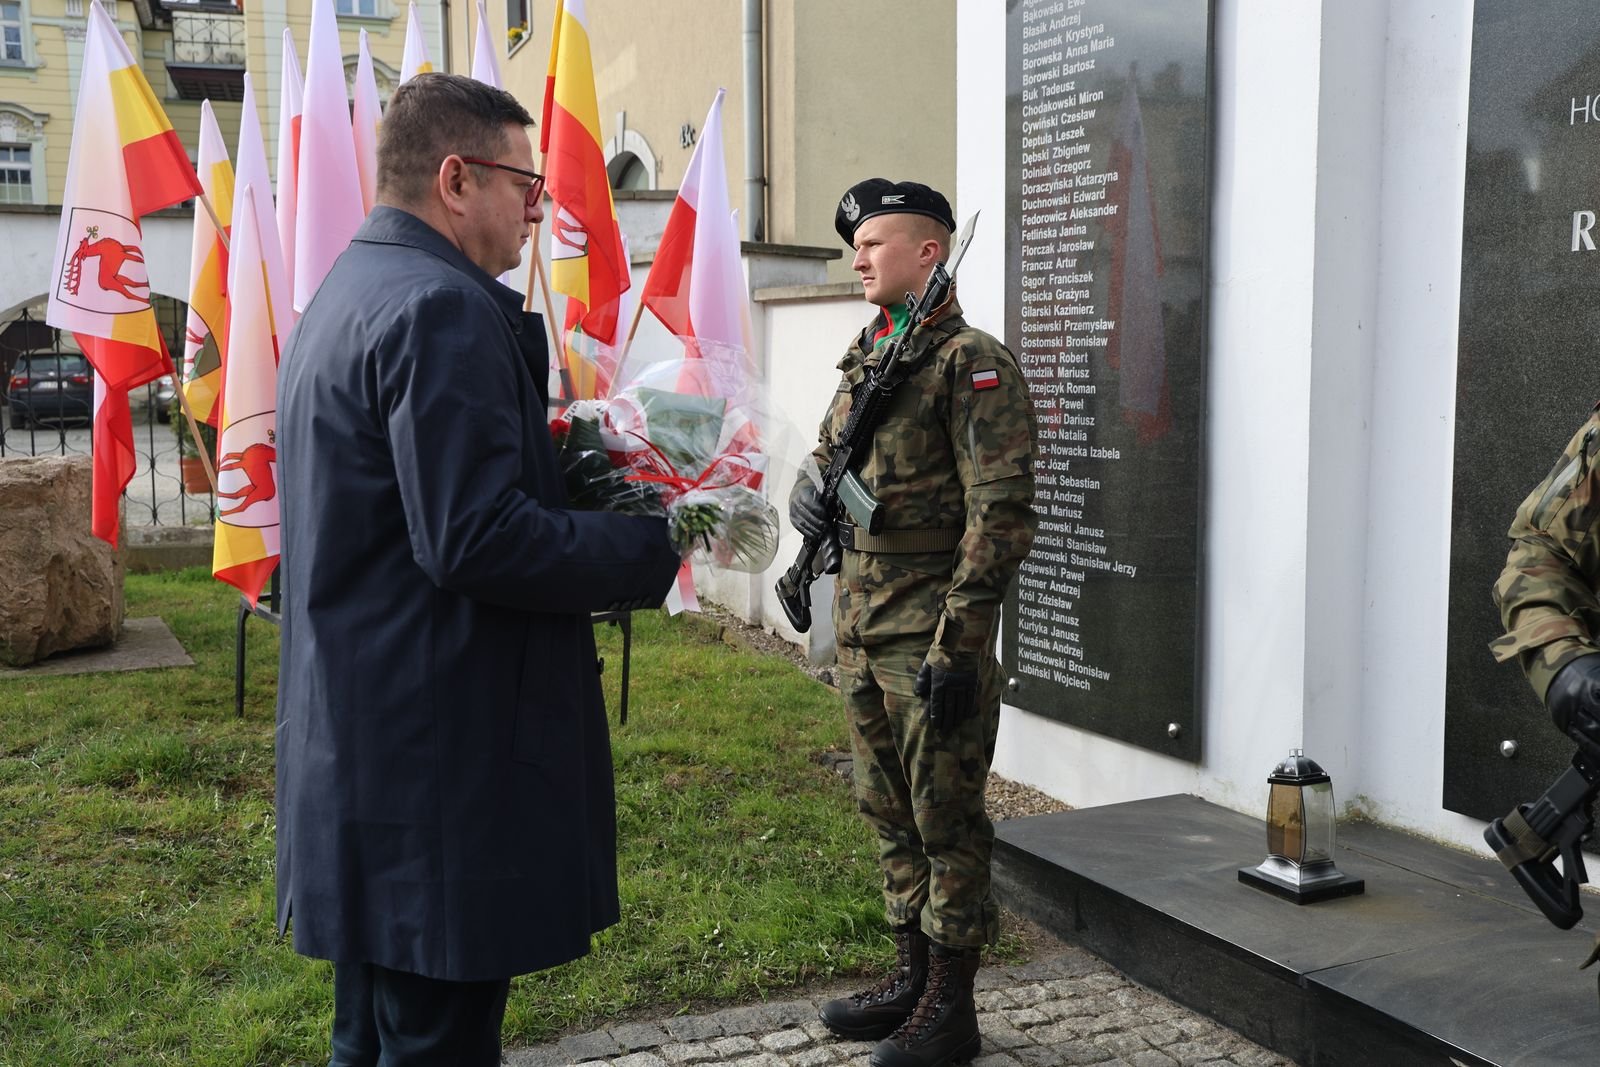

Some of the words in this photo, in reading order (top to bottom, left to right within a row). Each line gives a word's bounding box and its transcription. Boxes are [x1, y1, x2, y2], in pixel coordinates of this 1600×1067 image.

[1023, 1, 1063, 23] Bąkowska
[1023, 22, 1047, 38] Błasik
[1049, 12, 1080, 31] Andrzej
[1023, 36, 1062, 54] Bochenek
[1066, 23, 1104, 42] Krystyna
[1023, 51, 1062, 70] Borowska
[1066, 44, 1088, 59] Anna
[1091, 36, 1114, 52] Maria
[1023, 67, 1059, 86] Borowski
[1063, 59, 1095, 76] Bartosz
[1023, 89, 1038, 102] Buk
[1042, 81, 1075, 96] Tadeusz
[1023, 96, 1076, 117] Chodakowski
[1079, 90, 1104, 104] Miron
[1022, 116, 1058, 134] Cywiński
[1061, 108, 1096, 124] Czesław
[1056, 126, 1085, 141] Leszek
[1022, 149, 1049, 165] Dębski
[1052, 143, 1090, 160] Zbigniew
[1022, 165, 1051, 180] Dolniak
[1054, 159, 1091, 174] Grzegorz
[1022, 178, 1072, 195] Doraczyńska
[1076, 170, 1118, 187] Katarzyna
[1022, 194, 1070, 210] Duchnowski
[1073, 188, 1105, 203] Edward
[1022, 210, 1067, 226] Fedorowicz
[1070, 204, 1118, 219] Aleksander
[1022, 228, 1057, 241] Fetlińska
[1059, 224, 1086, 236] Janina
[1022, 243, 1054, 256] Florczak
[1057, 240, 1094, 254] Jarosław
[1022, 260, 1052, 272] Francuz
[1056, 258, 1077, 268] Artur
[1022, 276, 1045, 289] Gągor
[1049, 271, 1093, 285] Franciszek
[1022, 291, 1052, 304] Gęsicka
[1056, 288, 1089, 302] Grażyna
[1022, 306, 1051, 317] Gilarski
[1054, 304, 1094, 316] Kazimierz
[1022, 320, 1061, 332] Gosiewski
[1064, 318, 1115, 333] Przemysław
[1021, 336, 1062, 348] Gostomski
[1066, 336, 1108, 346] Bronisław
[1021, 353, 1056, 365] Grzywna
[1060, 352, 1088, 363] Robert
[1058, 367, 1090, 378] Mariusz
[1066, 383, 1096, 394] Roman
[1064, 414, 1095, 426] Dariusz
[1058, 430, 1087, 441] Natalia
[1090, 446, 1120, 459] Izabela
[1048, 460, 1070, 471] Józef
[1060, 475, 1100, 489] Sebastian
[1053, 491, 1084, 506] Andrzej
[1051, 505, 1082, 519] Mariusz
[1074, 524, 1104, 538] Janusz
[1066, 538, 1106, 554] Stanisław
[1019, 560, 1056, 576] Krajewski
[1060, 567, 1085, 582] Paweł
[1029, 548, 1068, 563] morowski
[1071, 554, 1111, 571] Stanisław
[1113, 561, 1136, 578] Jerzy
[1019, 574, 1047, 590] Kremer
[1050, 580, 1080, 599] Andrzej
[1019, 589, 1034, 602] Król
[1038, 592, 1072, 610] Zdzisław
[1019, 604, 1048, 620] Krupski
[1051, 610, 1080, 627] Janusz
[1019, 618, 1048, 634] Kurtyka
[1051, 626, 1080, 642] Janusz
[1018, 633, 1050, 650] Kwaśnik
[1052, 642, 1083, 660] Andrzej
[1018, 648, 1066, 669] Kwiatkowski
[1069, 660, 1110, 681] Bronisław
[1018, 662, 1050, 680] Lubiński
[1054, 670, 1090, 690] Wojciech
